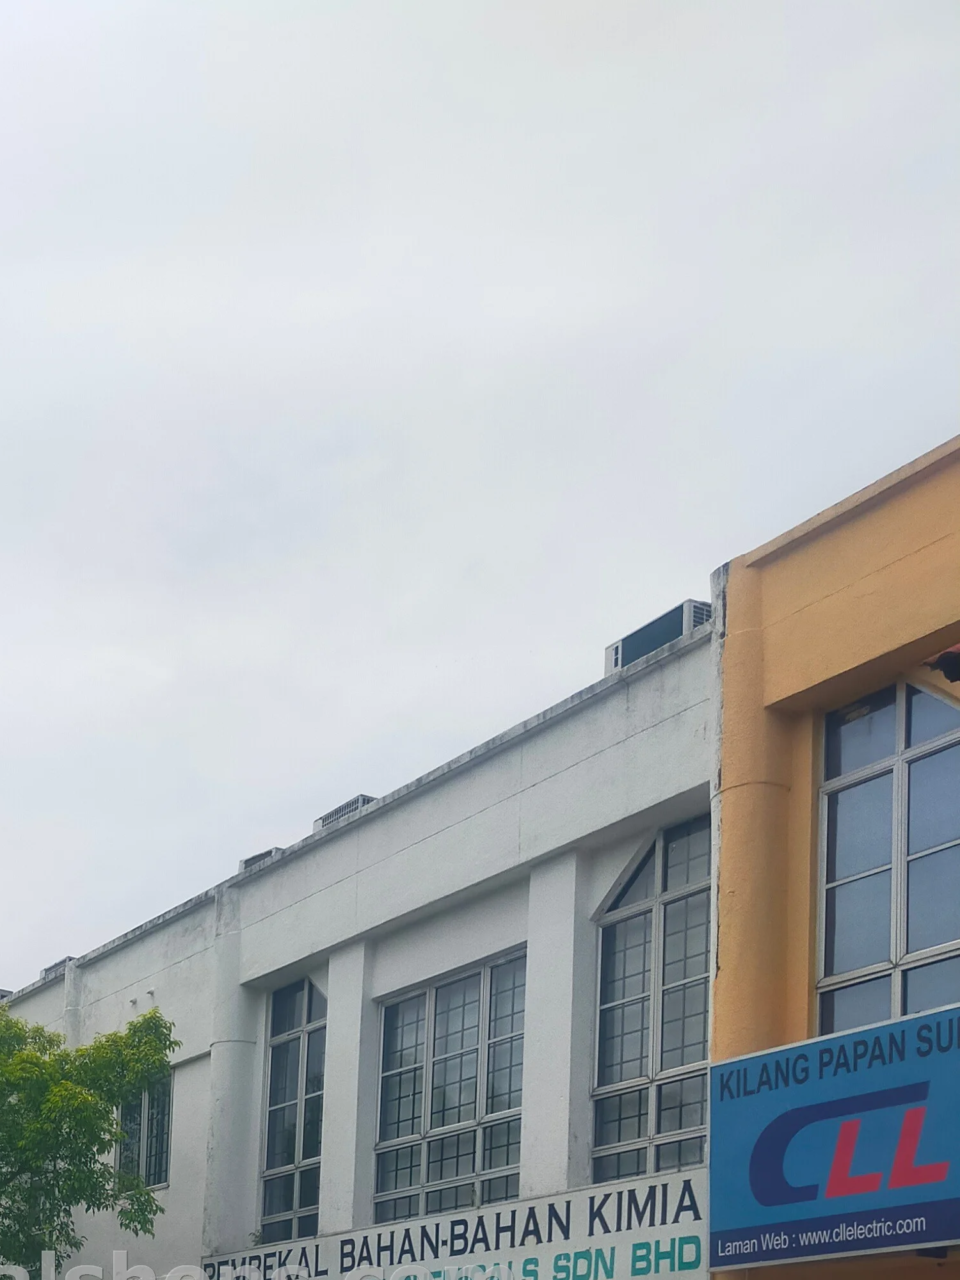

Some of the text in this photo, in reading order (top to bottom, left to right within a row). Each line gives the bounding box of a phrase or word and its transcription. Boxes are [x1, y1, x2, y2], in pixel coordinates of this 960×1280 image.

[719, 1016, 960, 1101] KILANG PAPAN SU
[748, 1080, 951, 1208] CLL
[339, 1200, 572, 1275] BAHAN-BAHAN
[587, 1178, 703, 1237] KIMIA
[631, 1235, 702, 1277] BHD
[718, 1238, 758, 1257] Laman
[760, 1231, 789, 1251] Web
[798, 1216, 926, 1247] www.cllelectric.com
